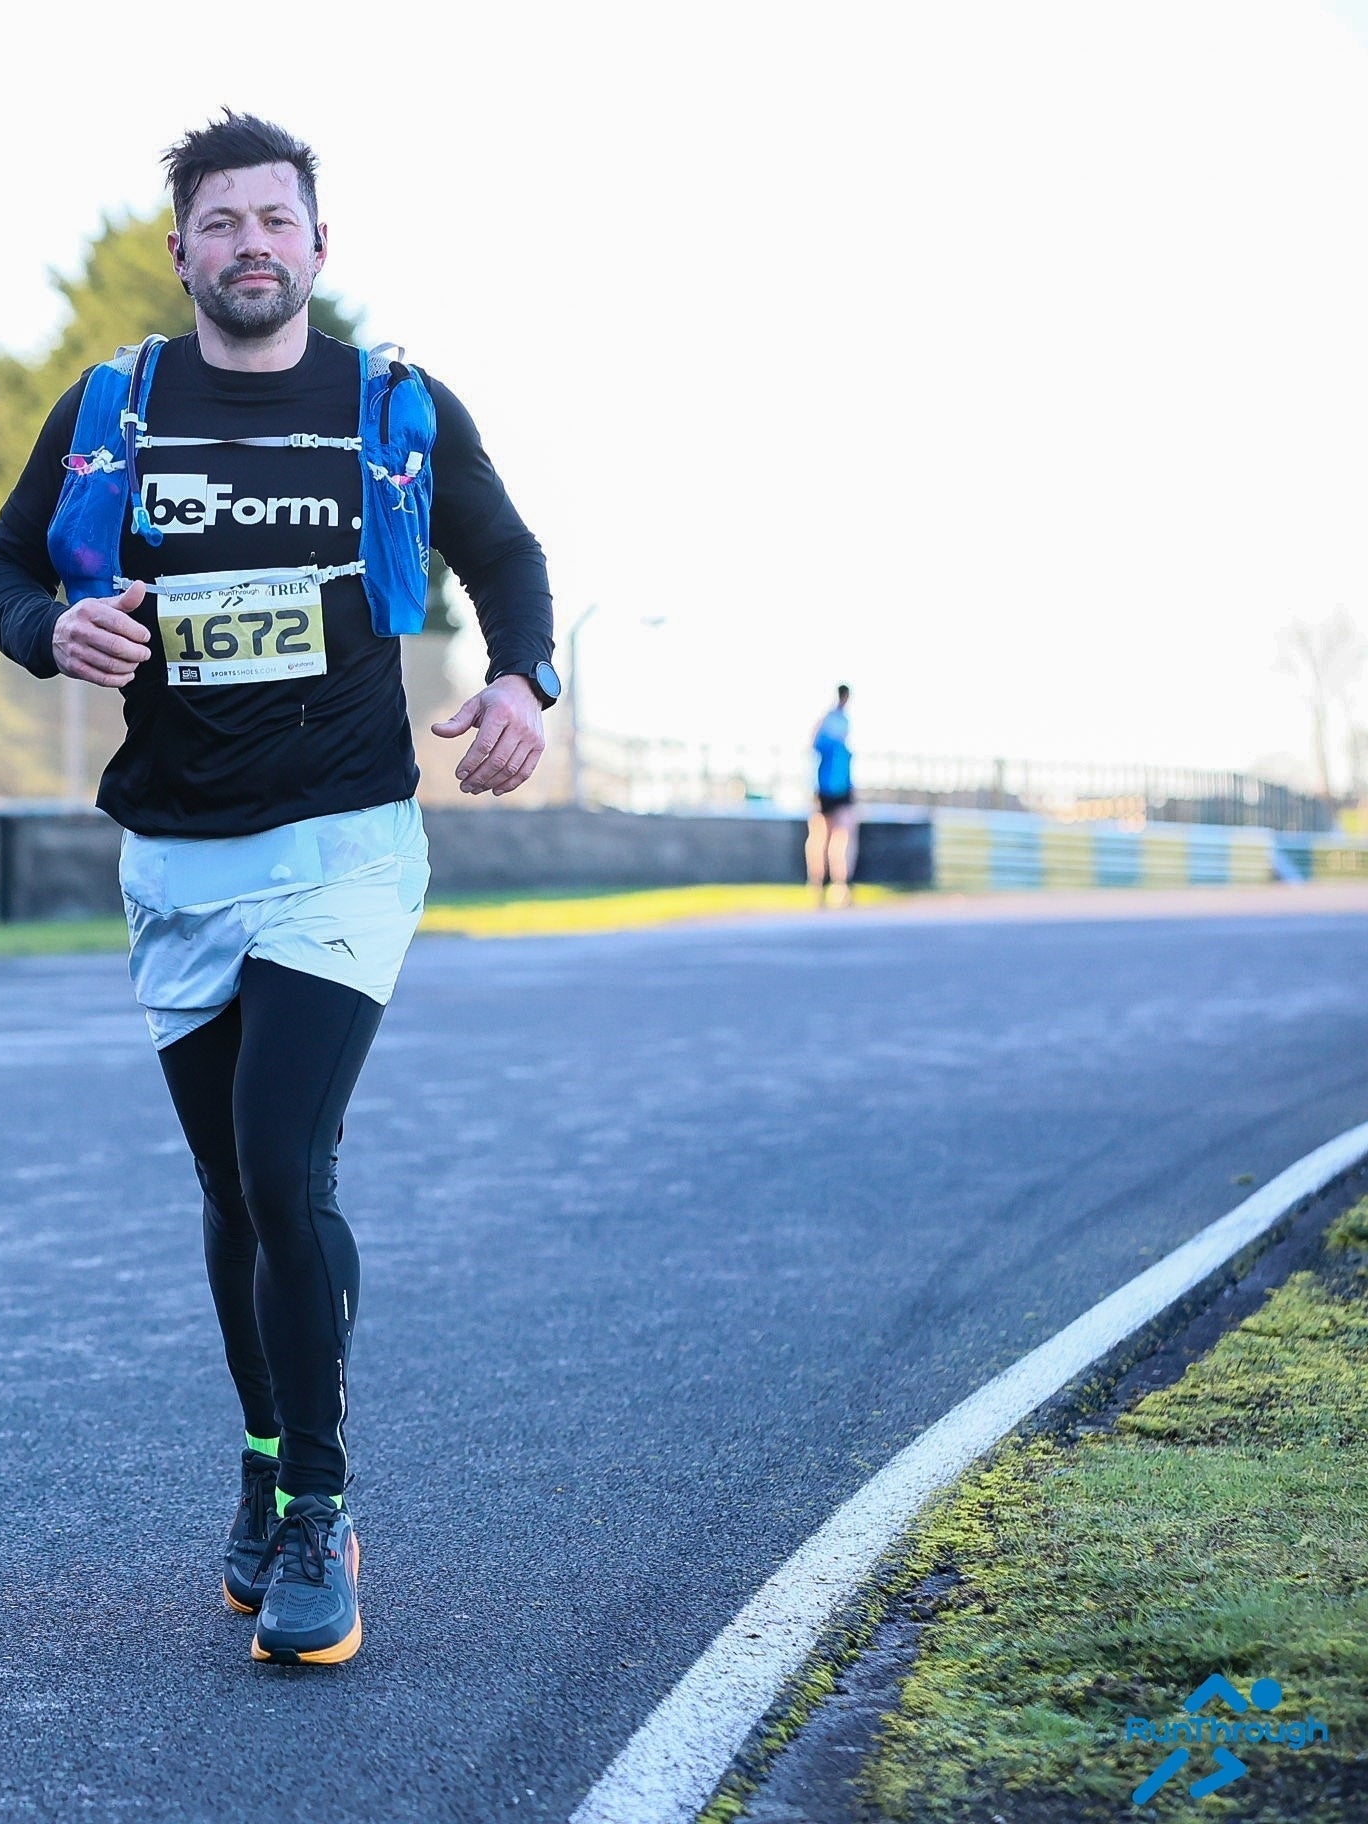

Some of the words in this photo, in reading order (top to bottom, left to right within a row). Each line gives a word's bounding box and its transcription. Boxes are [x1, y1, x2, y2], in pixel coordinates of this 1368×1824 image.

[169, 590, 212, 602] BROOKS
[218, 587, 260, 598] RunThrough
[268, 582, 309, 597] TREK
[175, 609, 312, 660] 1672
